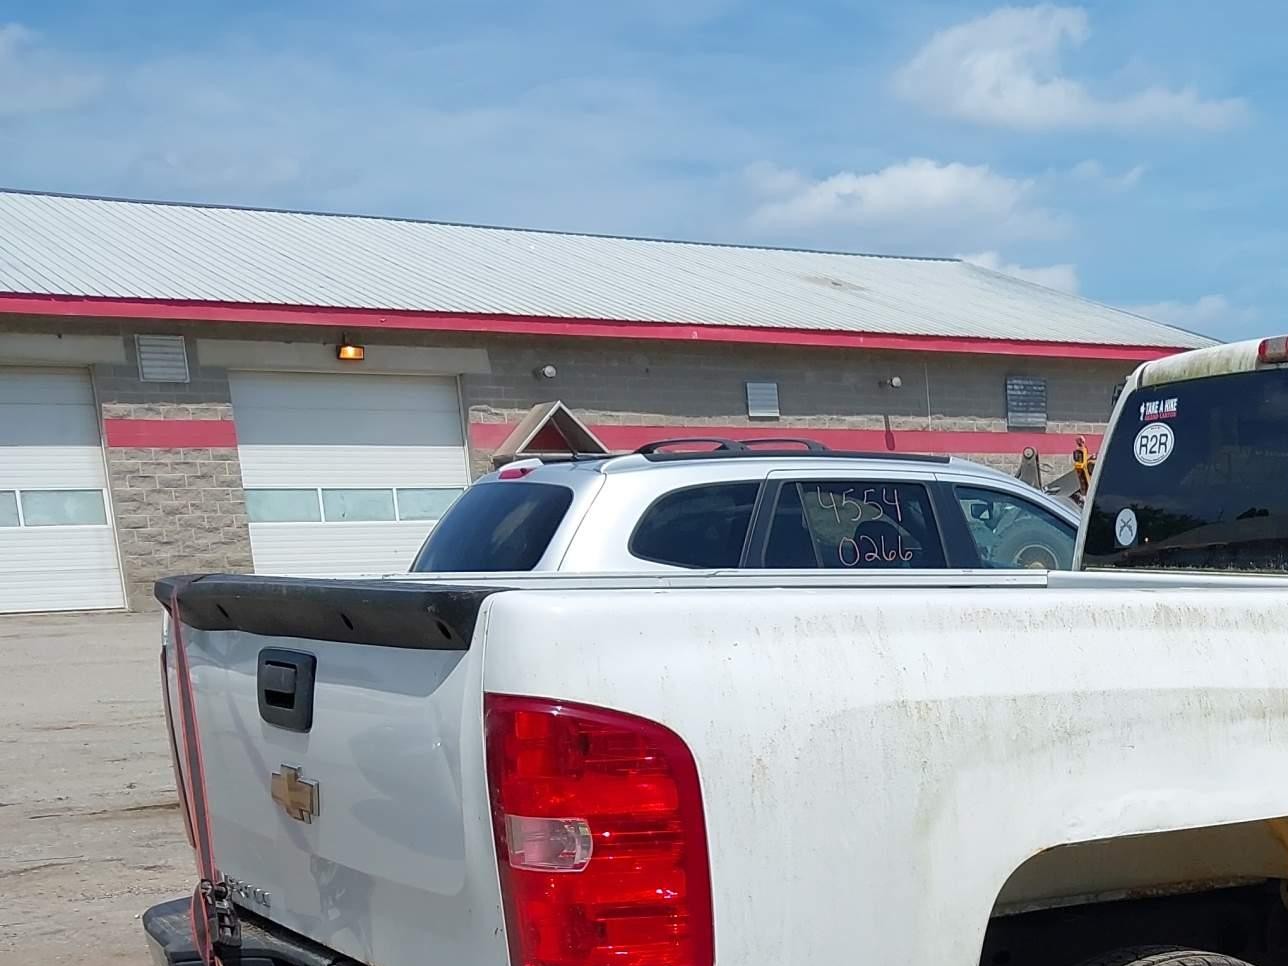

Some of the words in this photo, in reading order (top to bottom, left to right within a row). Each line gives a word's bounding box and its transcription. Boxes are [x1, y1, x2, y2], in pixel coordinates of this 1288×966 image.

[1139, 433, 1169, 456] R2R
[816, 486, 902, 524] 4554
[838, 535, 913, 567] 0266
